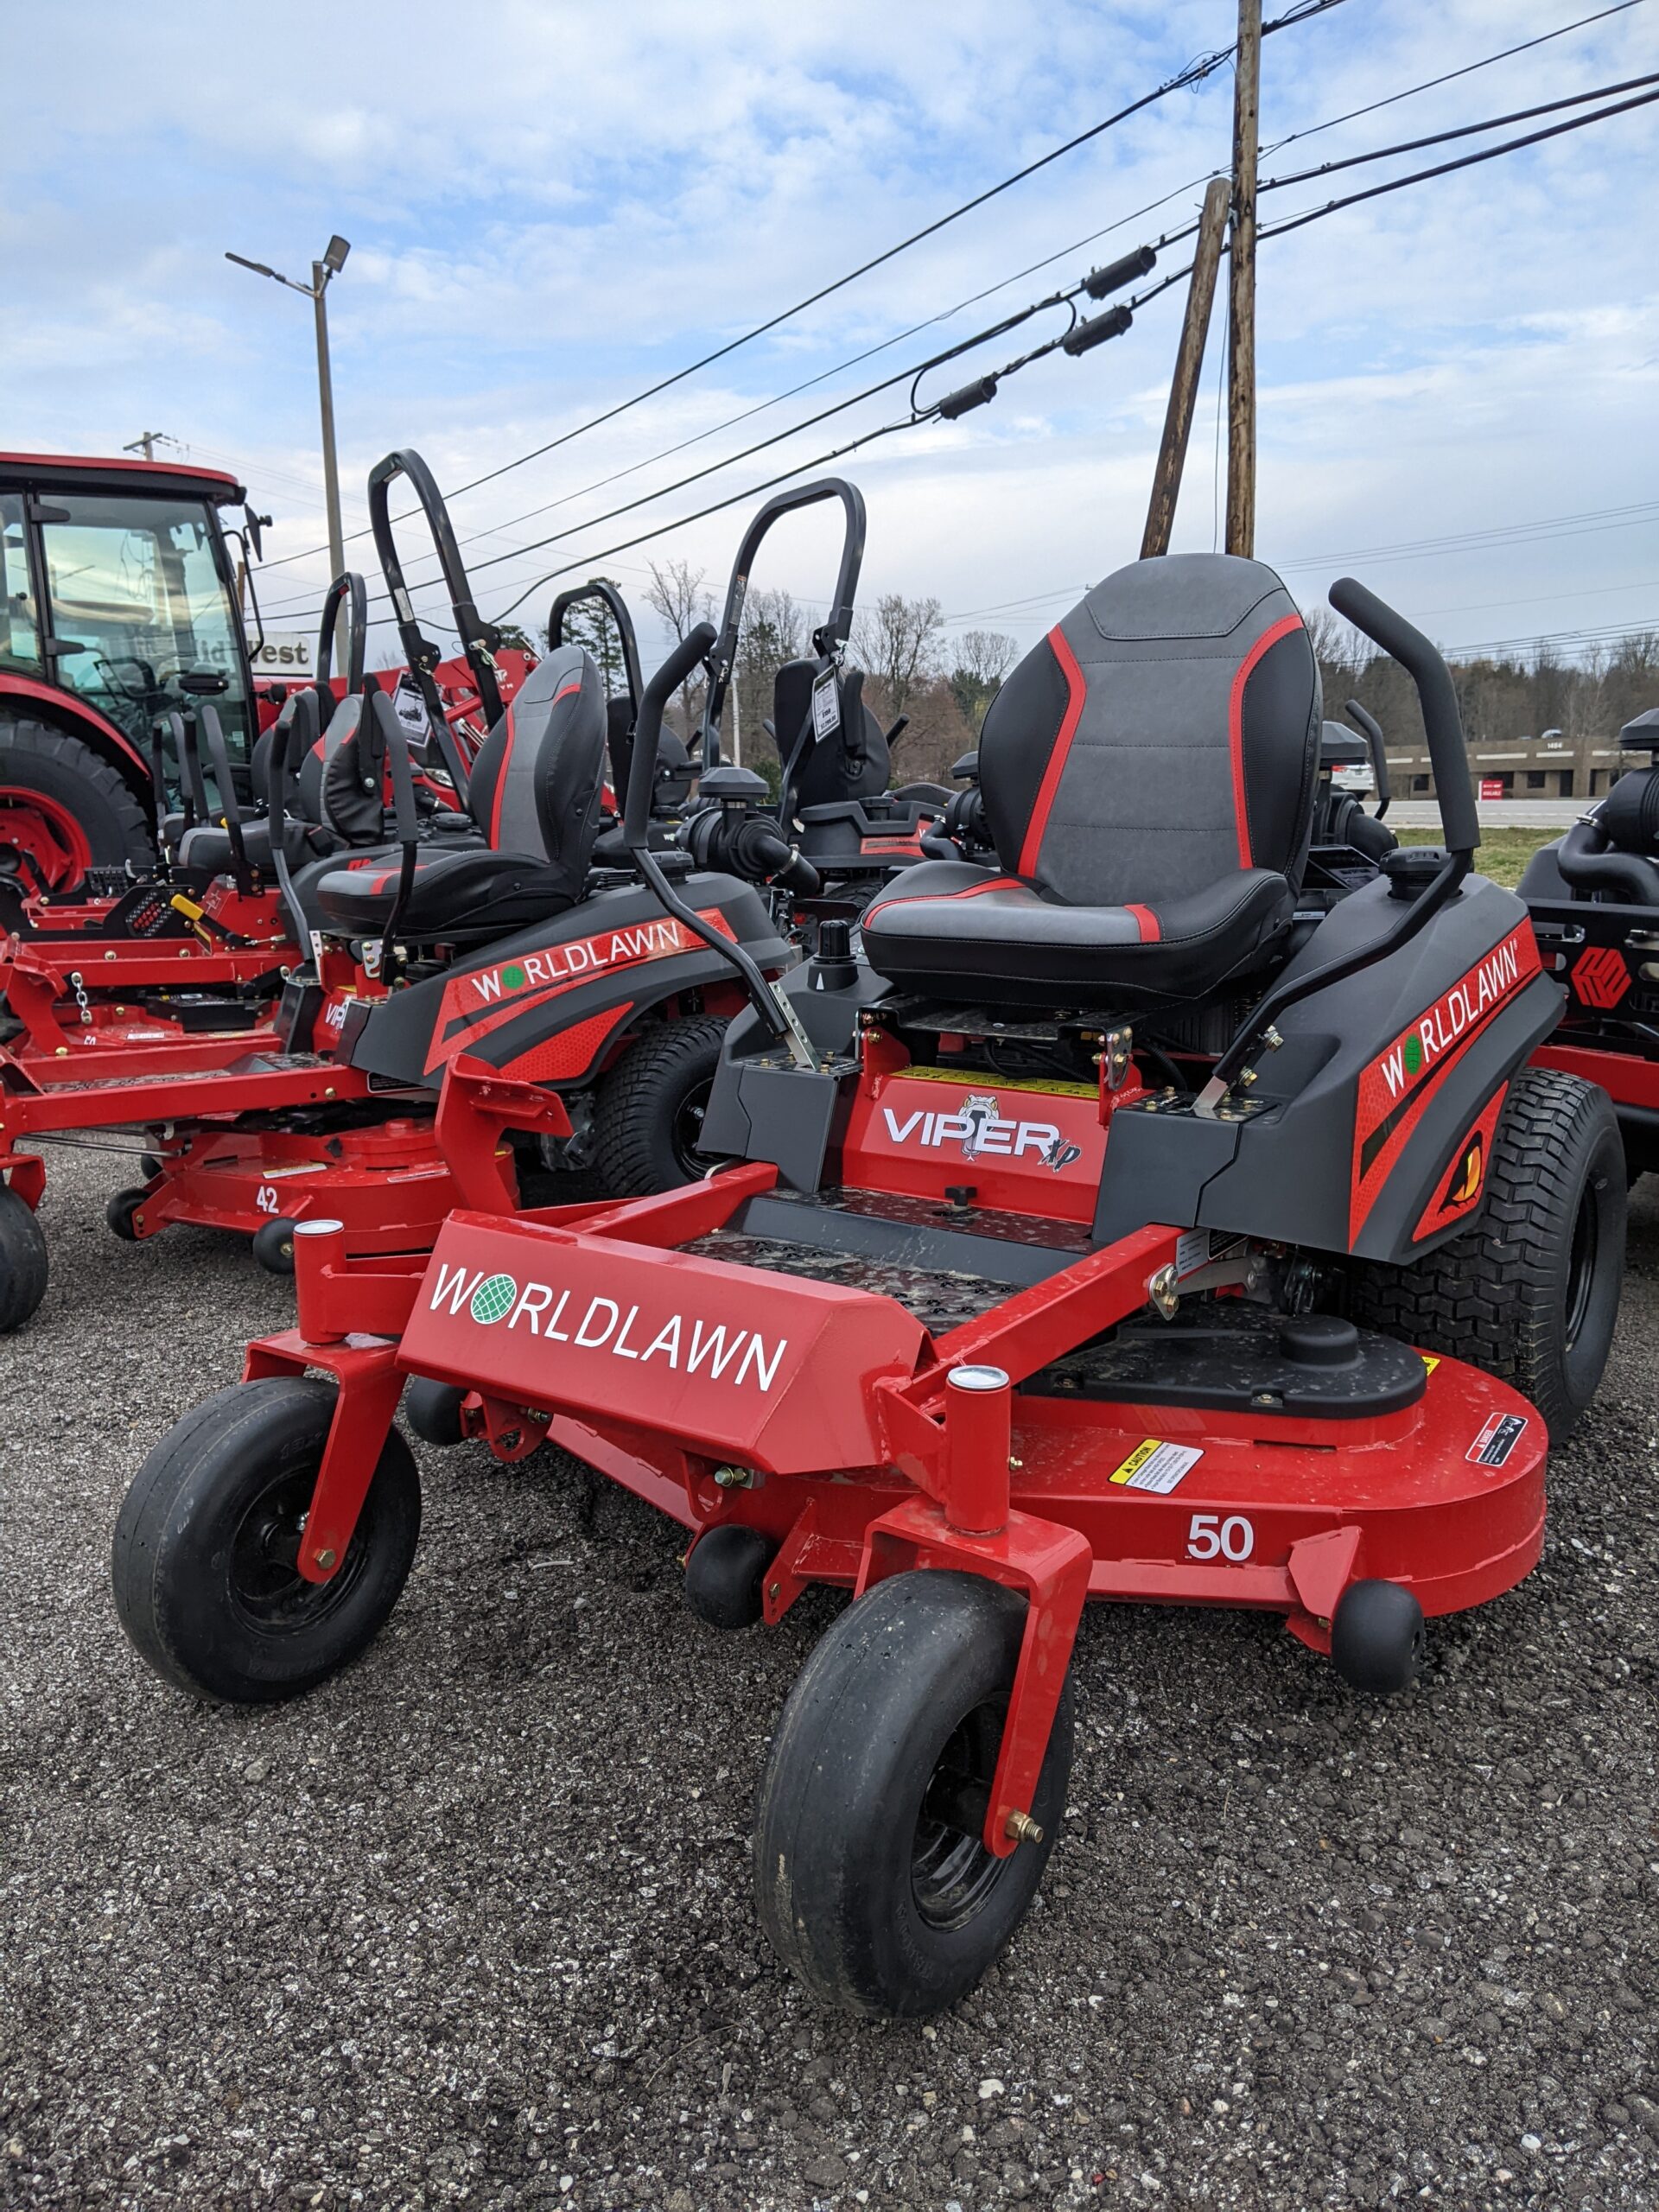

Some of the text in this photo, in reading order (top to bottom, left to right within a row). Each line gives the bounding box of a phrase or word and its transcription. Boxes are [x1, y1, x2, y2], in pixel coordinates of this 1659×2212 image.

[883, 1108, 1060, 1157] VIPER
[257, 1185, 279, 1214] 42
[1128, 1446, 1153, 1466] CAUTION
[1187, 1515, 1254, 1561] 50
